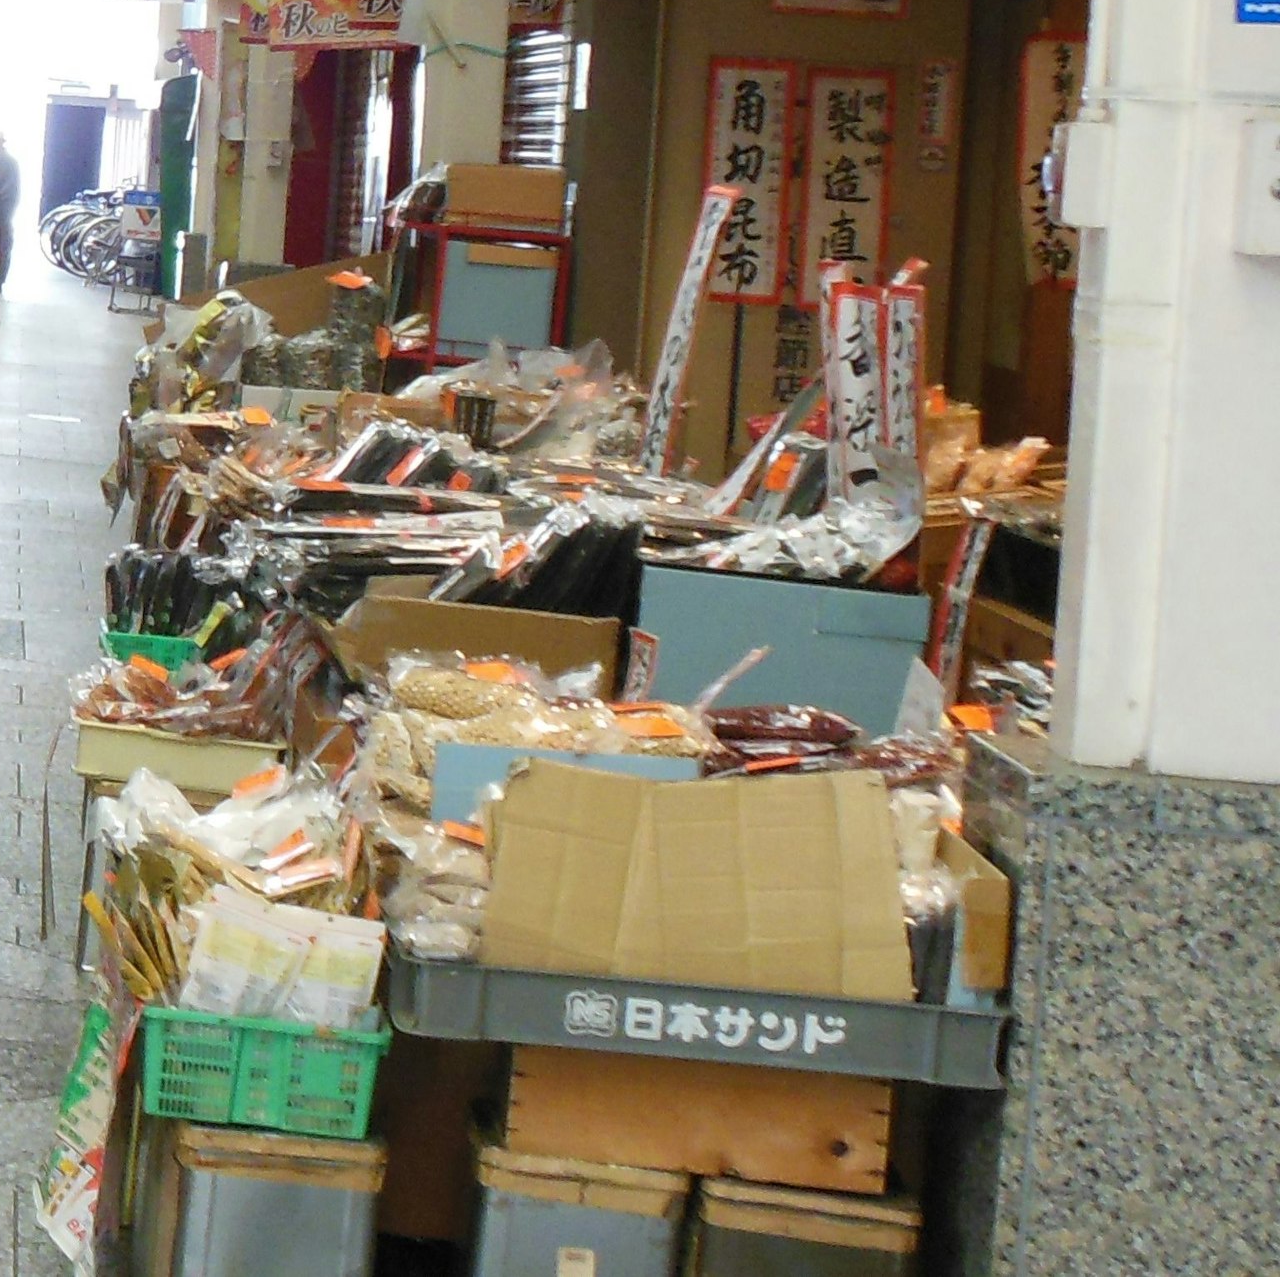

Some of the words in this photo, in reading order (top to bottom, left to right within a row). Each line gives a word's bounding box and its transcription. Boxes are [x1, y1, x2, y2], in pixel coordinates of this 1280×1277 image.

[717, 78, 767, 293] 角切昆布
[624, 996, 848, 1055] 日本サンド
